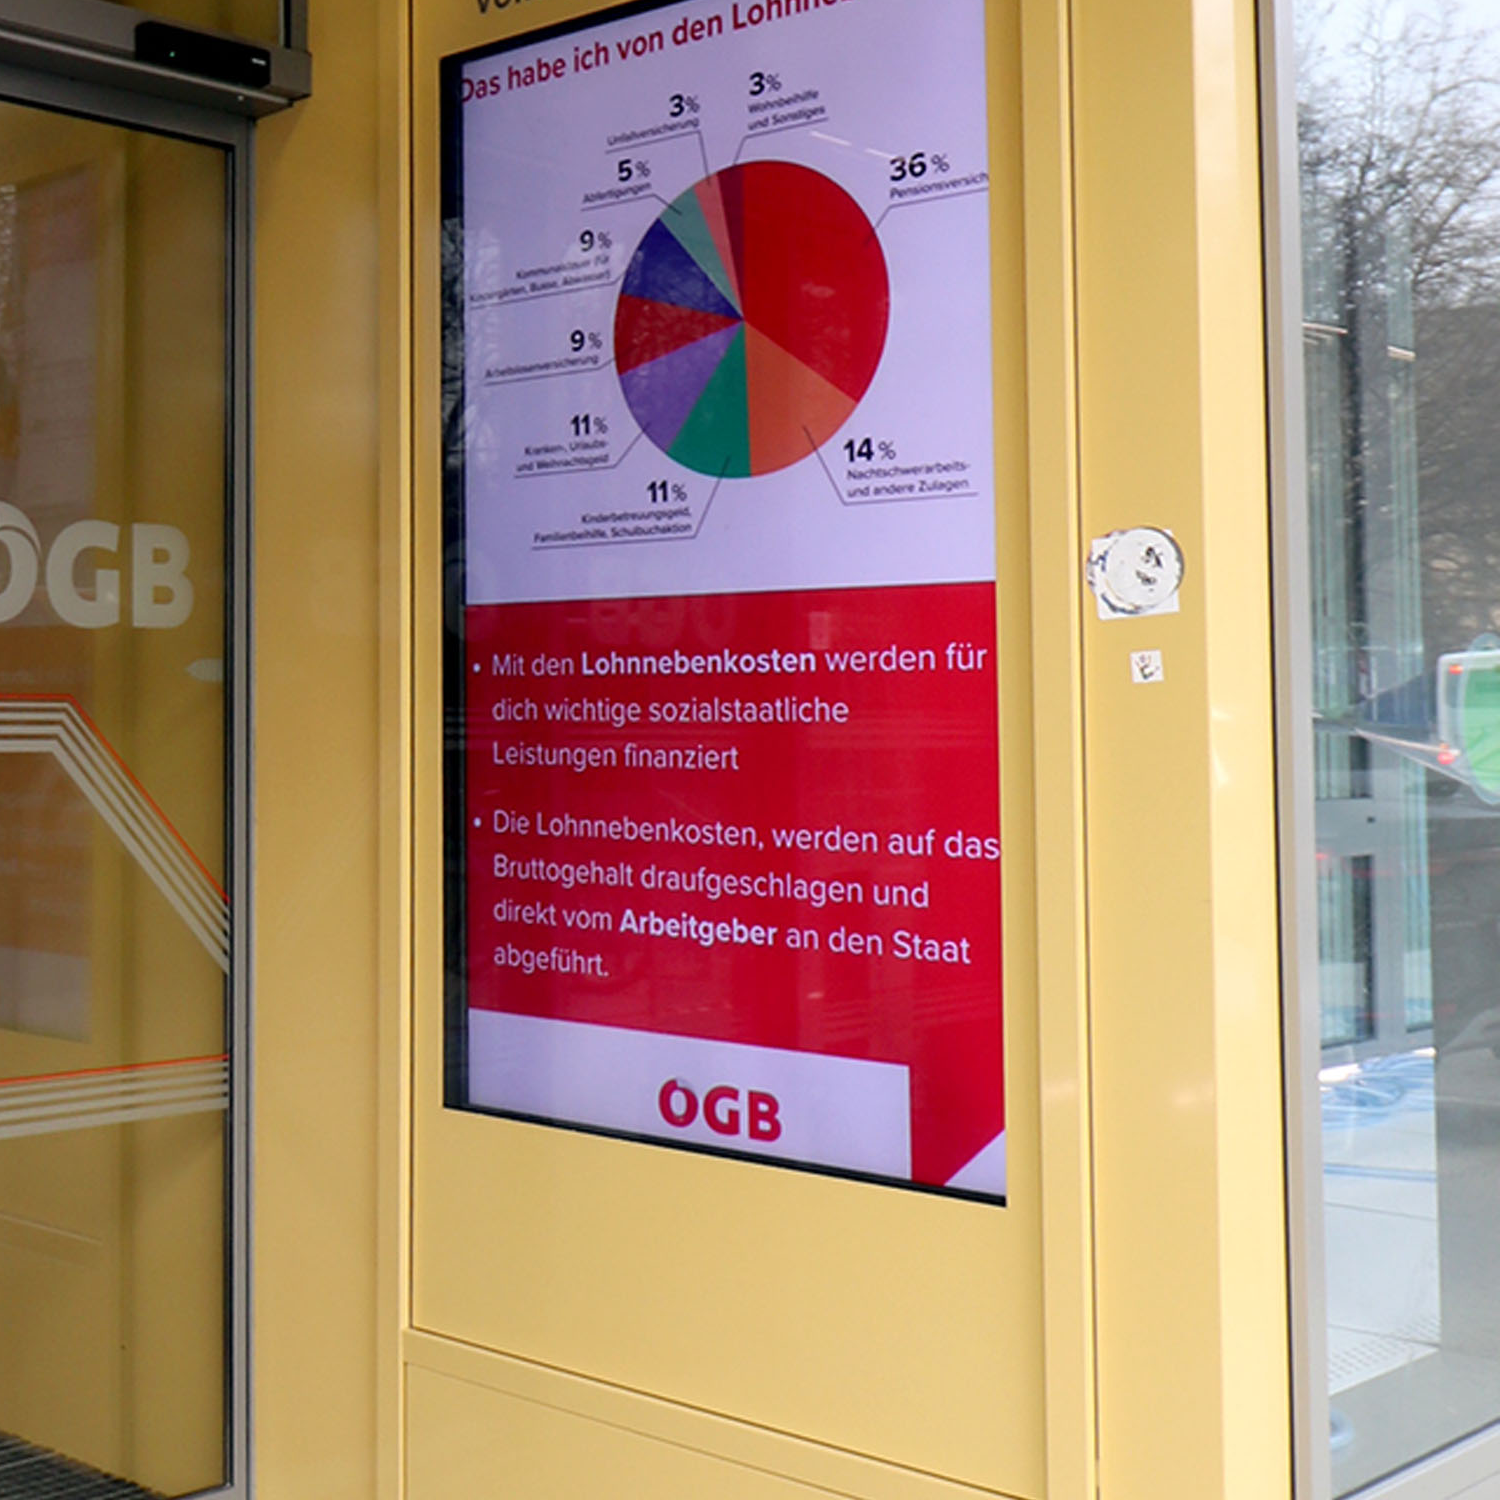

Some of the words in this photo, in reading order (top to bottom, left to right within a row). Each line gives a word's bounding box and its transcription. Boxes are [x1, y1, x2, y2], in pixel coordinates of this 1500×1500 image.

[461, 76, 500, 102] Das
[507, 58, 566, 90] habe
[574, 40, 609, 73] ich
[617, 30, 664, 62] von
[672, 8, 723, 47] den
[748, 89, 819, 114] Wohnbeihilfe
[607, 117, 700, 145] Unfallversicherung
[748, 117, 769, 131] und
[771, 104, 826, 127] Sonstiges
[582, 182, 652, 204] Abfertigungen
[516, 462, 533, 472] und
[536, 454, 609, 471] Weihnachtsgeld
[847, 486, 869, 498] und
[873, 483, 915, 495] andere
[918, 479, 969, 493] Zulagen
[611, 523, 692, 538] Schulbuchaktion
[492, 653, 527, 677] Mit
[531, 652, 575, 677] den
[581, 648, 817, 677] Lohnnebenkosten
[825, 643, 936, 672] werden
[945, 642, 988, 670] für
[492, 697, 538, 722] dich
[543, 697, 641, 728] wichtige
[648, 696, 850, 724] sozialstaatliche
[492, 742, 617, 773] Leistungen
[623, 743, 739, 771] finanziert
[493, 810, 529, 835] Die
[536, 812, 765, 851] Lohnnebenkosten,
[772, 824, 878, 855] werden
[887, 829, 935, 857] auf
[944, 831, 1001, 860] das
[493, 854, 634, 892] Bruttogehalt
[640, 866, 863, 908] draufgeschlagen
[872, 881, 930, 909] und
[493, 898, 557, 927] direkt
[562, 910, 613, 931] vom
[619, 908, 778, 948] Arbeitgeber
[786, 927, 819, 951] an
[828, 927, 883, 956] den
[892, 931, 972, 965] Staat
[493, 943, 610, 977] abgeführt.
